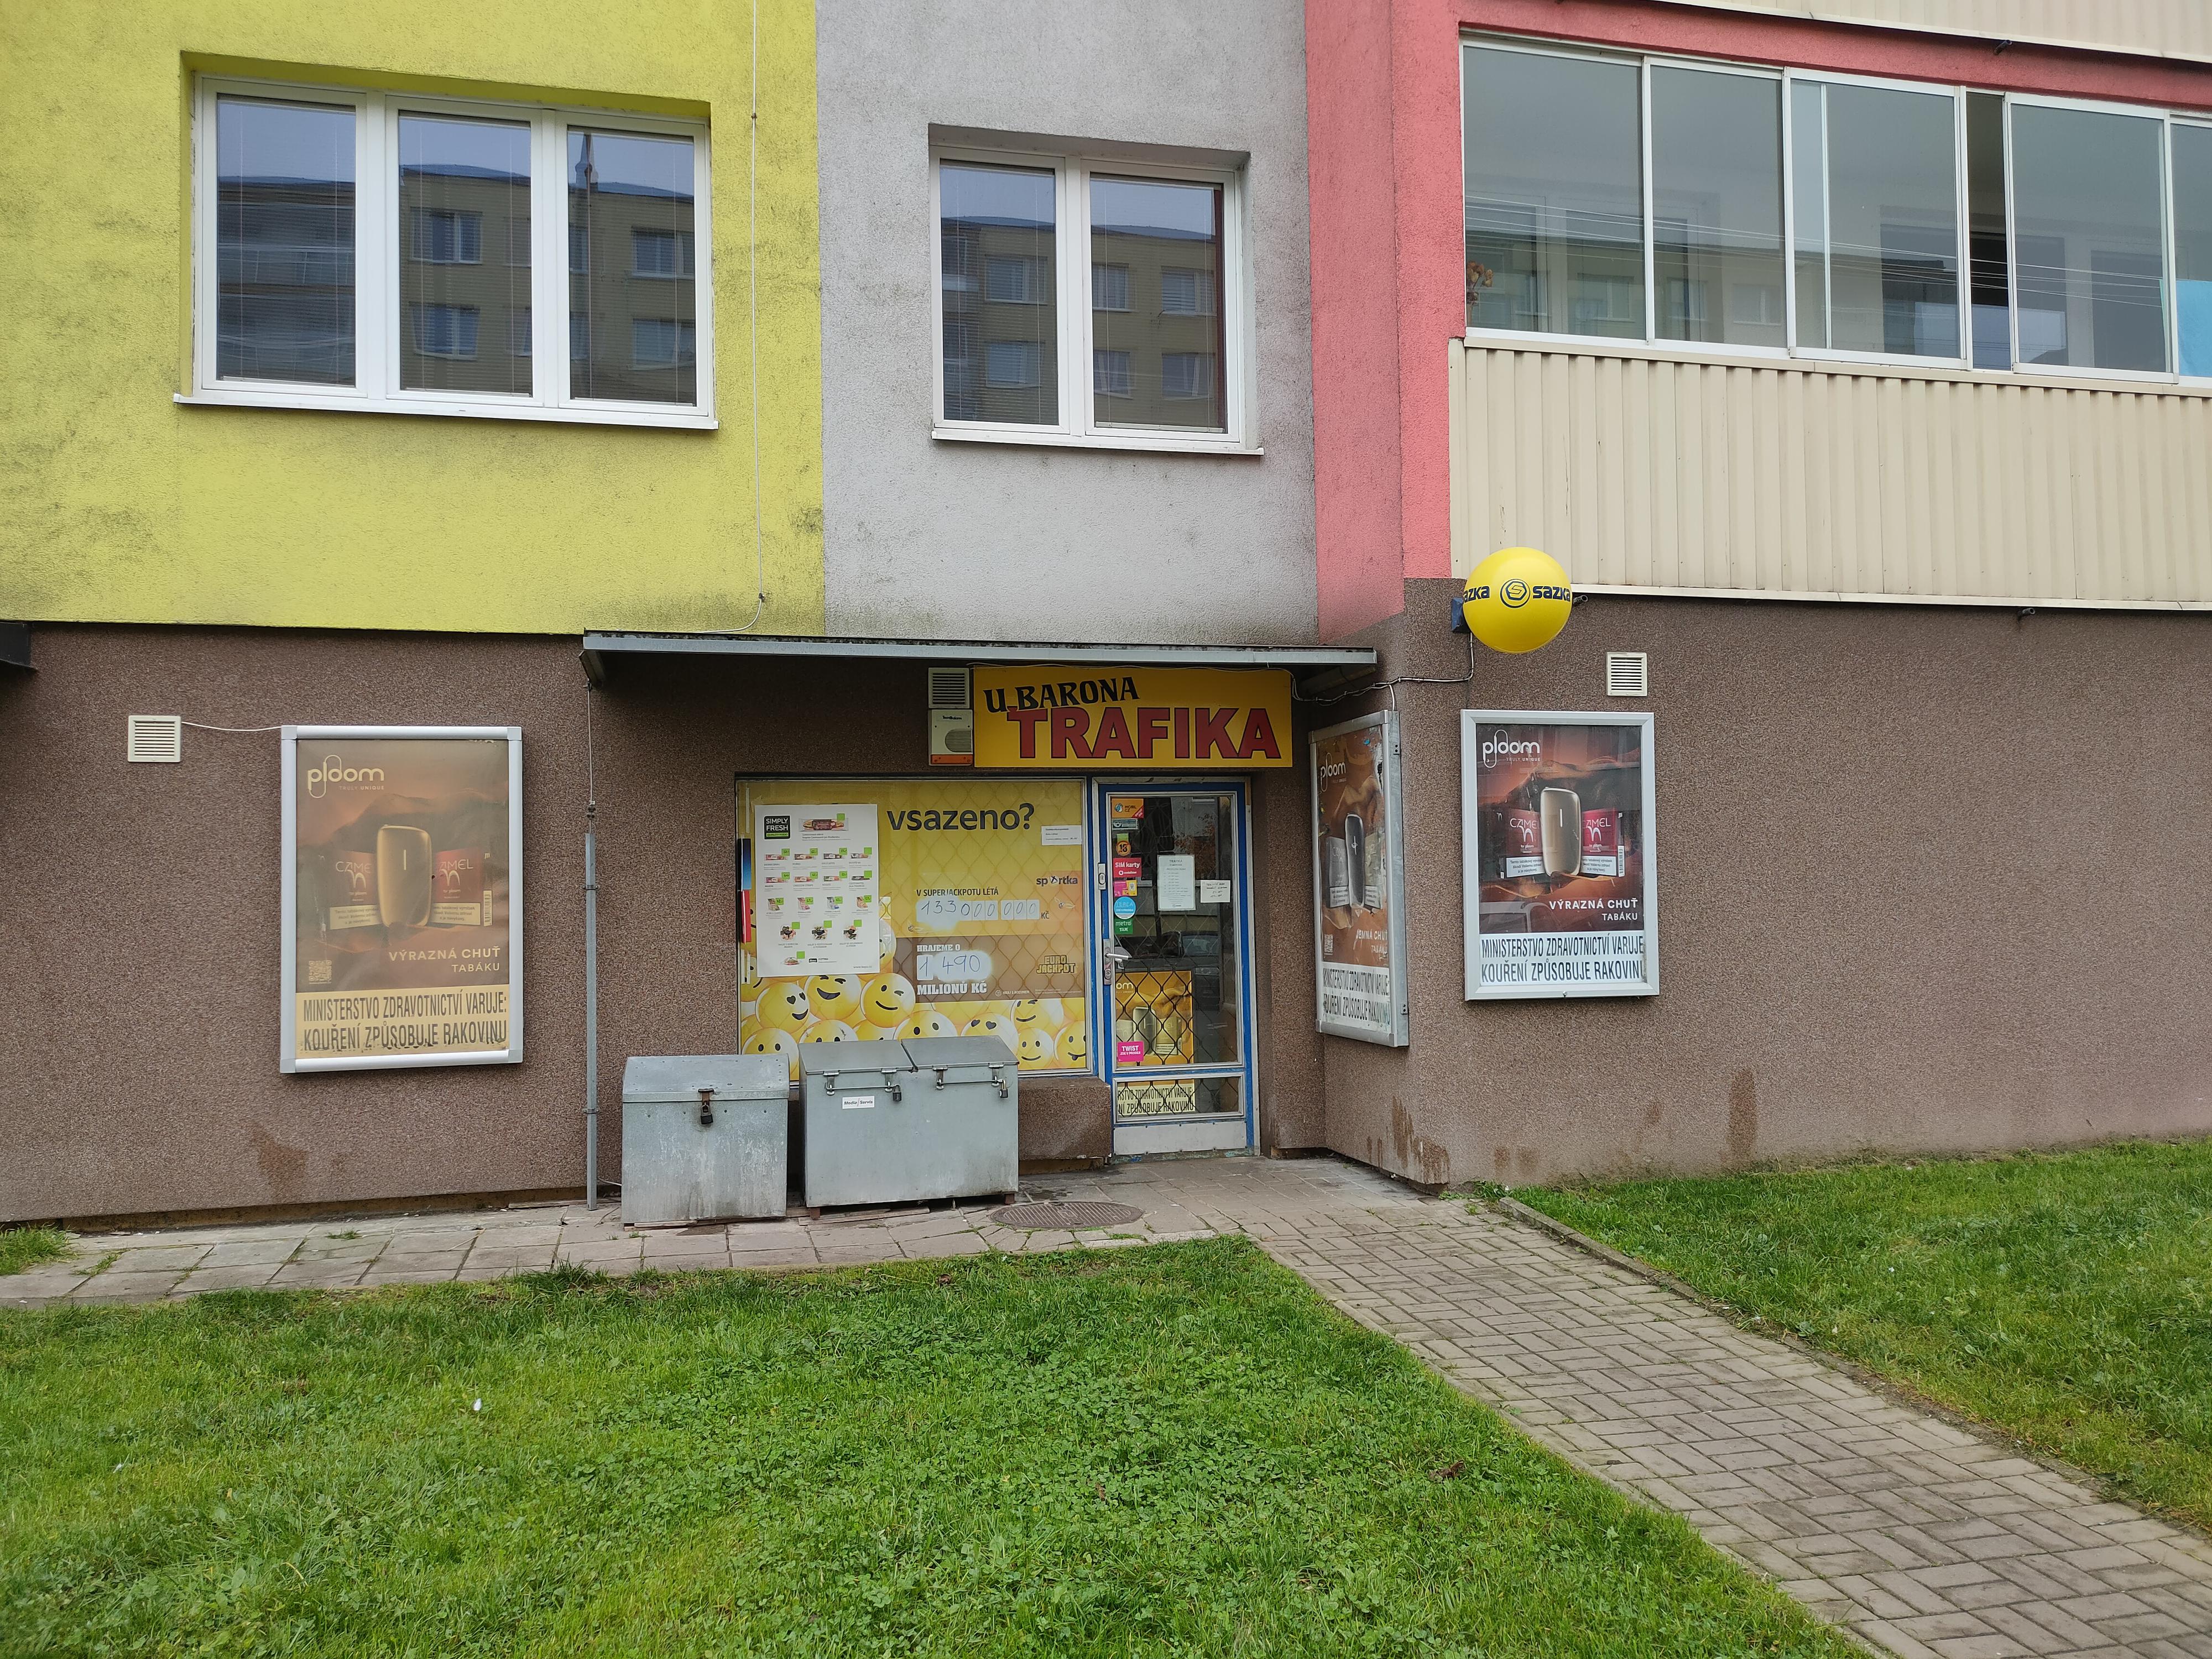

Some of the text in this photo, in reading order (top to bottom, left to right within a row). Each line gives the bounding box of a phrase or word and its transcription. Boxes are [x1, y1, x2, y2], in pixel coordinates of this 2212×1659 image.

[1463, 585, 1490, 603] azka
[1532, 585, 1571, 602] sazka
[1015, 676, 1140, 711] BARONA
[1006, 706, 1282, 759] TRAFIKA
[1483, 729, 1540, 768] ploom
[307, 754, 385, 799] ploom
[1320, 752, 1347, 792] ploom
[886, 802, 1035, 831] vsazeno?
[335, 860, 372, 873] CAME
[440, 859, 474, 872] AMEL
[983, 886, 999, 896] LÉTÁ
[1549, 898, 1638, 910] VÝRAZNÁ CHUŤ
[1041, 911, 1050, 919] KČ
[1602, 912, 1638, 921] TABÁKU
[388, 946, 500, 961] VÝRAZNÁ CHUŤ
[917, 944, 953, 952] HRAJEME
[1481, 938, 1544, 958] MINISTERSTVO
[1546, 932, 1610, 957] ZDRAVOTNICTVÍ
[451, 962, 500, 973] TABÁKU
[942, 954, 980, 975] 490
[1044, 954, 1068, 965] EURO
[1036, 963, 1076, 974] JACKPOT
[1481, 959, 1528, 983] KOUŘENÍ
[1531, 958, 1592, 982] ZPŮSOBUJE
[917, 980, 987, 995] MILIONŮ KČ
[304, 989, 507, 1022] MINISTERSTVO ZDRAVOTNICTVÍ VARUJE:
[304, 1020, 507, 1051] KOUŘENÍ ZPŮSOBUJE RAKOVINU
